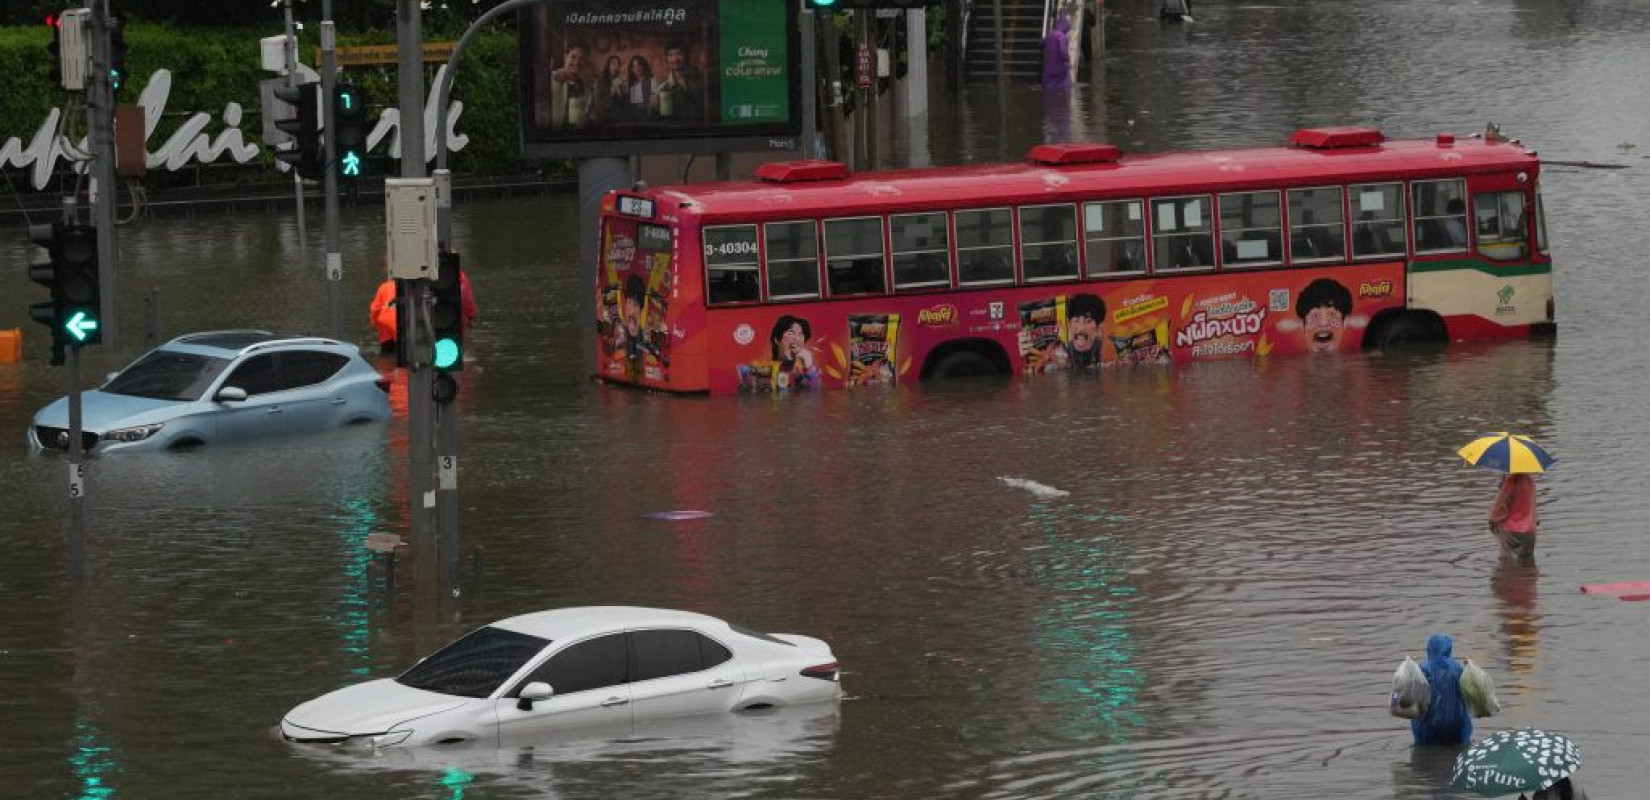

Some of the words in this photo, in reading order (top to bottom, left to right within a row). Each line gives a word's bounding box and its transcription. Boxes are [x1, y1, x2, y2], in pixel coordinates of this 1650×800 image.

[738, 47, 768, 59] Chang
[706, 241, 757, 255] 3-40304
[331, 268, 339, 280] 6
[443, 457, 452, 470] 3
[70, 483, 80, 497] 5
[1465, 769, 1526, 789] S-Pure
